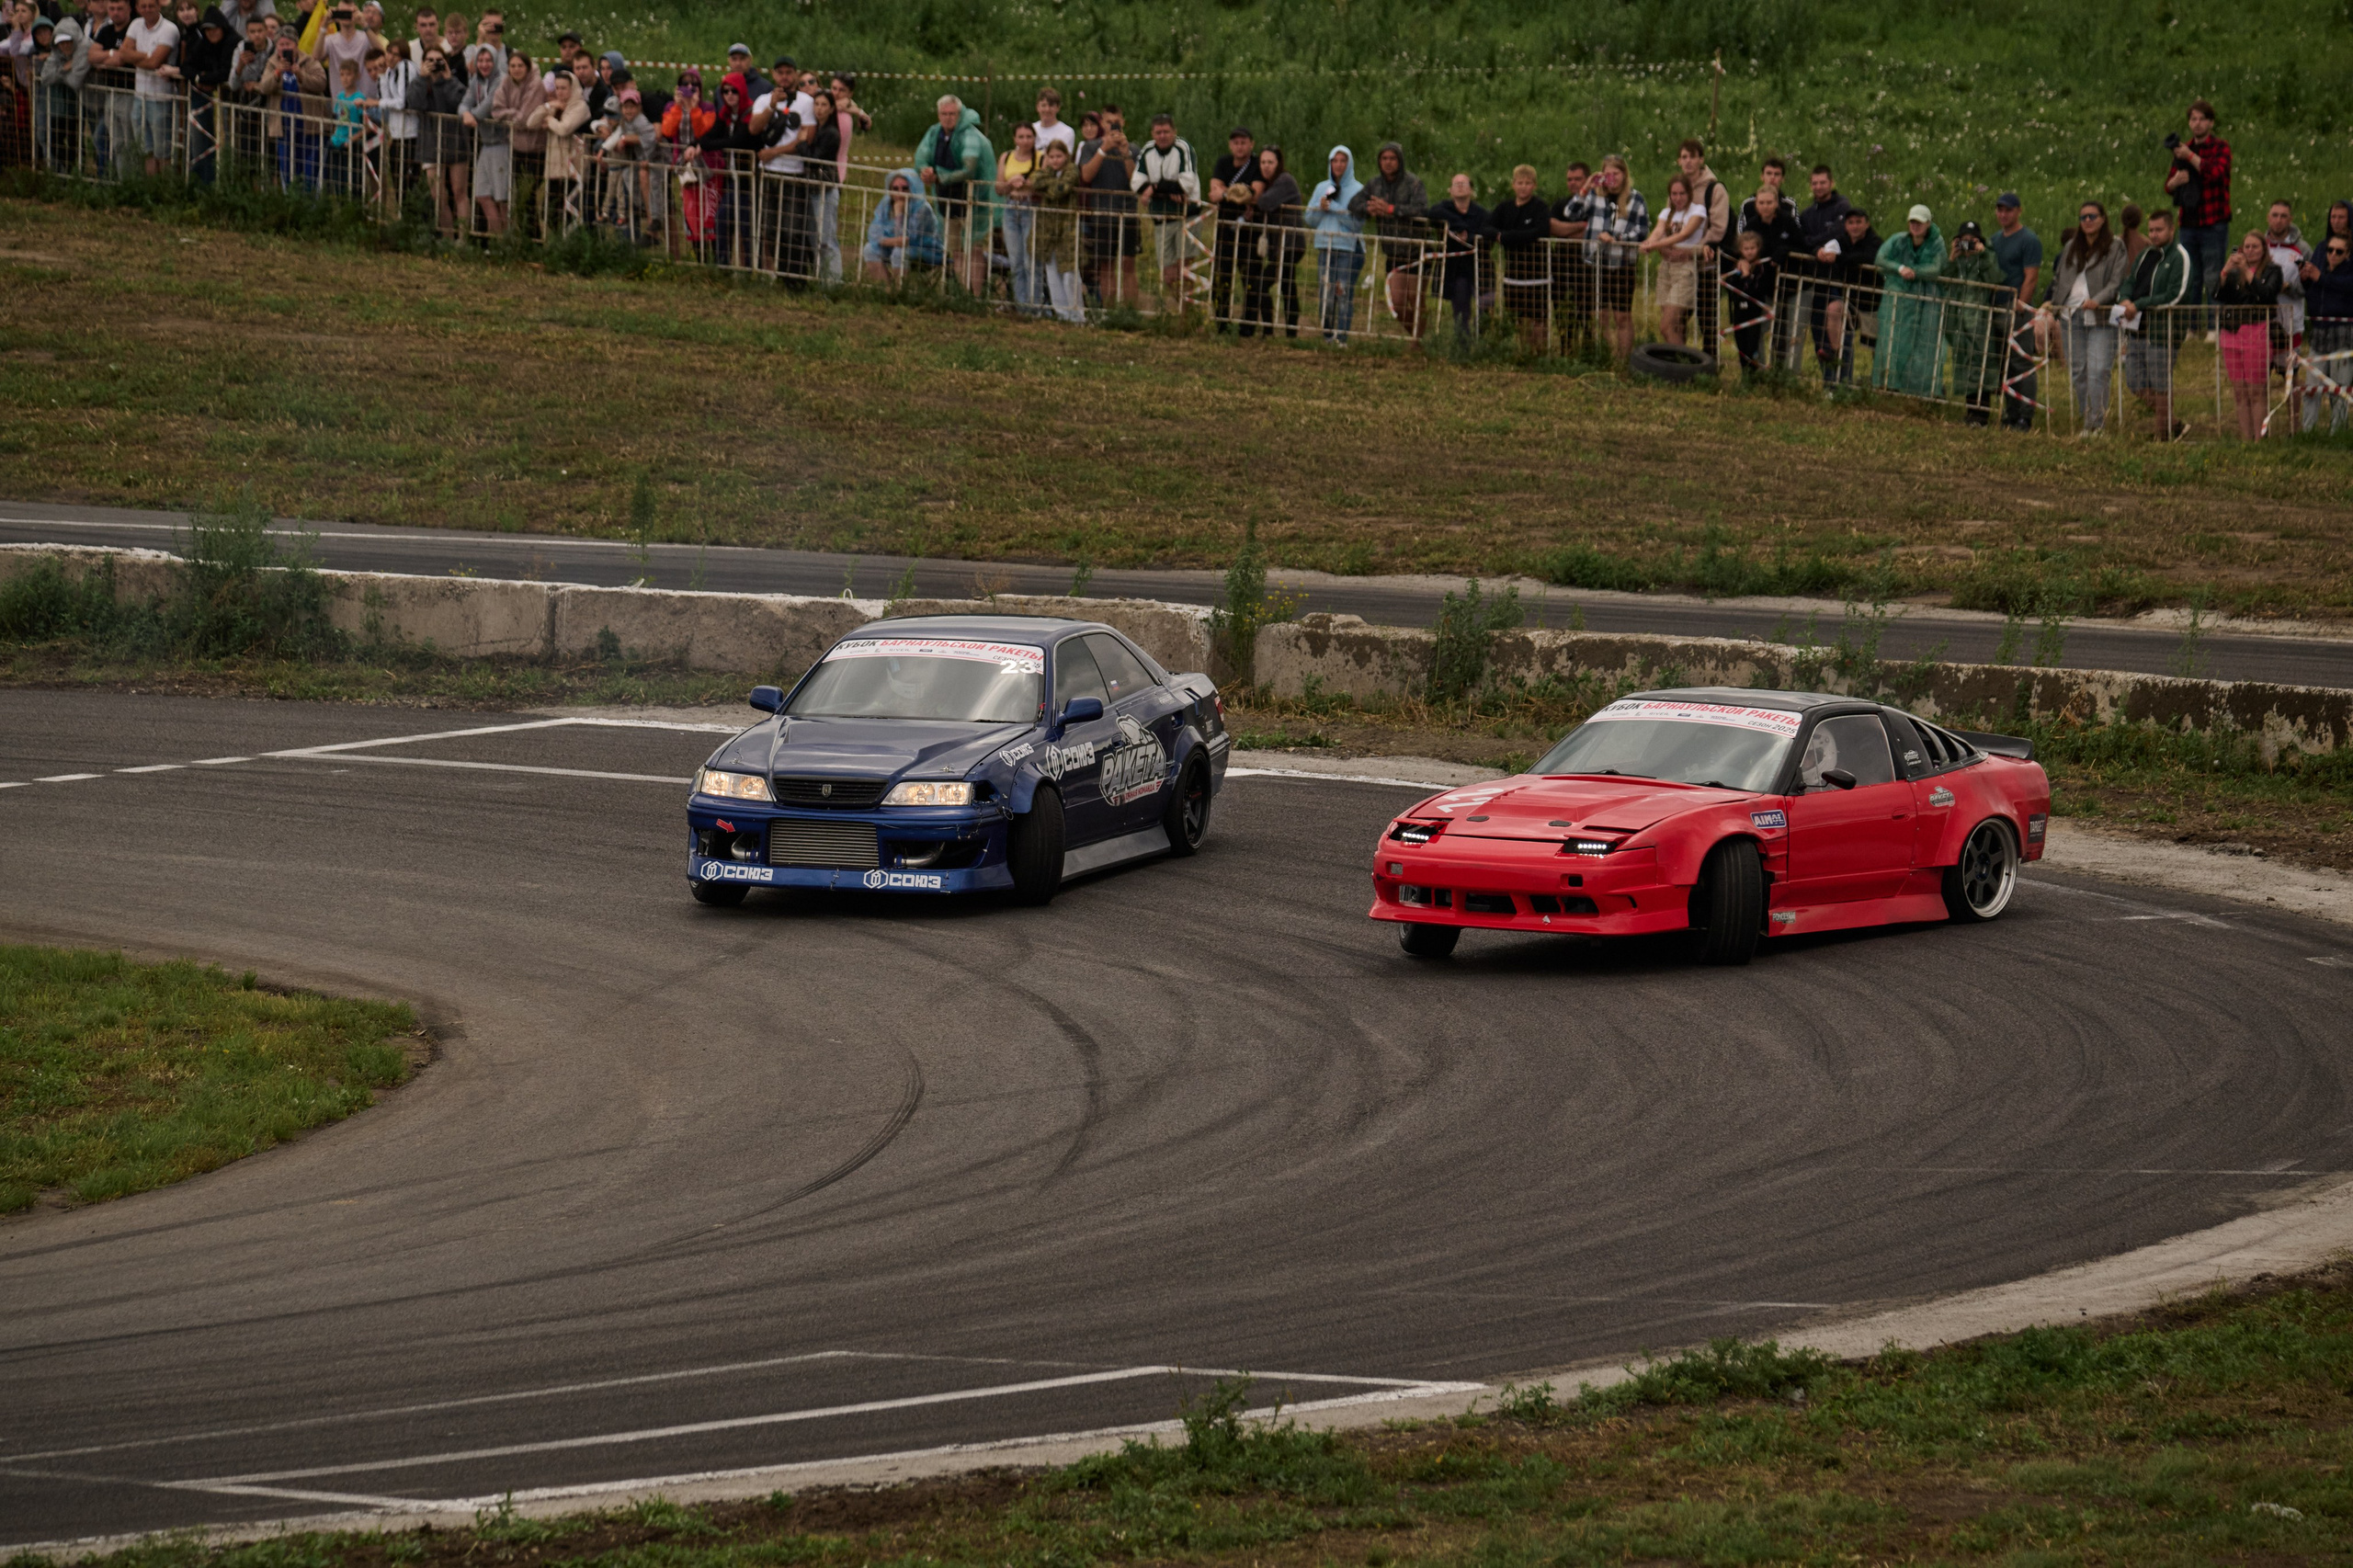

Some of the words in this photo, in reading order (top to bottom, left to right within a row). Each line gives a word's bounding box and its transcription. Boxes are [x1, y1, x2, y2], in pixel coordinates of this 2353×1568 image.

[835, 640, 881, 651] КУБОК
[880, 639, 986, 652] БАРНАУЛЬСКОЙ
[988, 645, 1044, 661] РАКЕТЫ
[1000, 660, 1037, 675] 23
[1601, 702, 1643, 712] КУБОК
[1643, 701, 1747, 715] БАРНАУЛЬСКОЙ
[1745, 710, 1802, 726] РАКЕТЫ
[1772, 724, 1798, 734] 2025
[1010, 743, 1034, 761] СОЮЗ
[1062, 742, 1096, 772] СОЮЗ
[1102, 744, 1165, 795] РАКЕТА
[1754, 813, 1784, 825] AIMOL
[2029, 820, 2045, 834] TARGET
[723, 865, 774, 881] СОЮЗ
[888, 872, 942, 890] СОЮЗ
